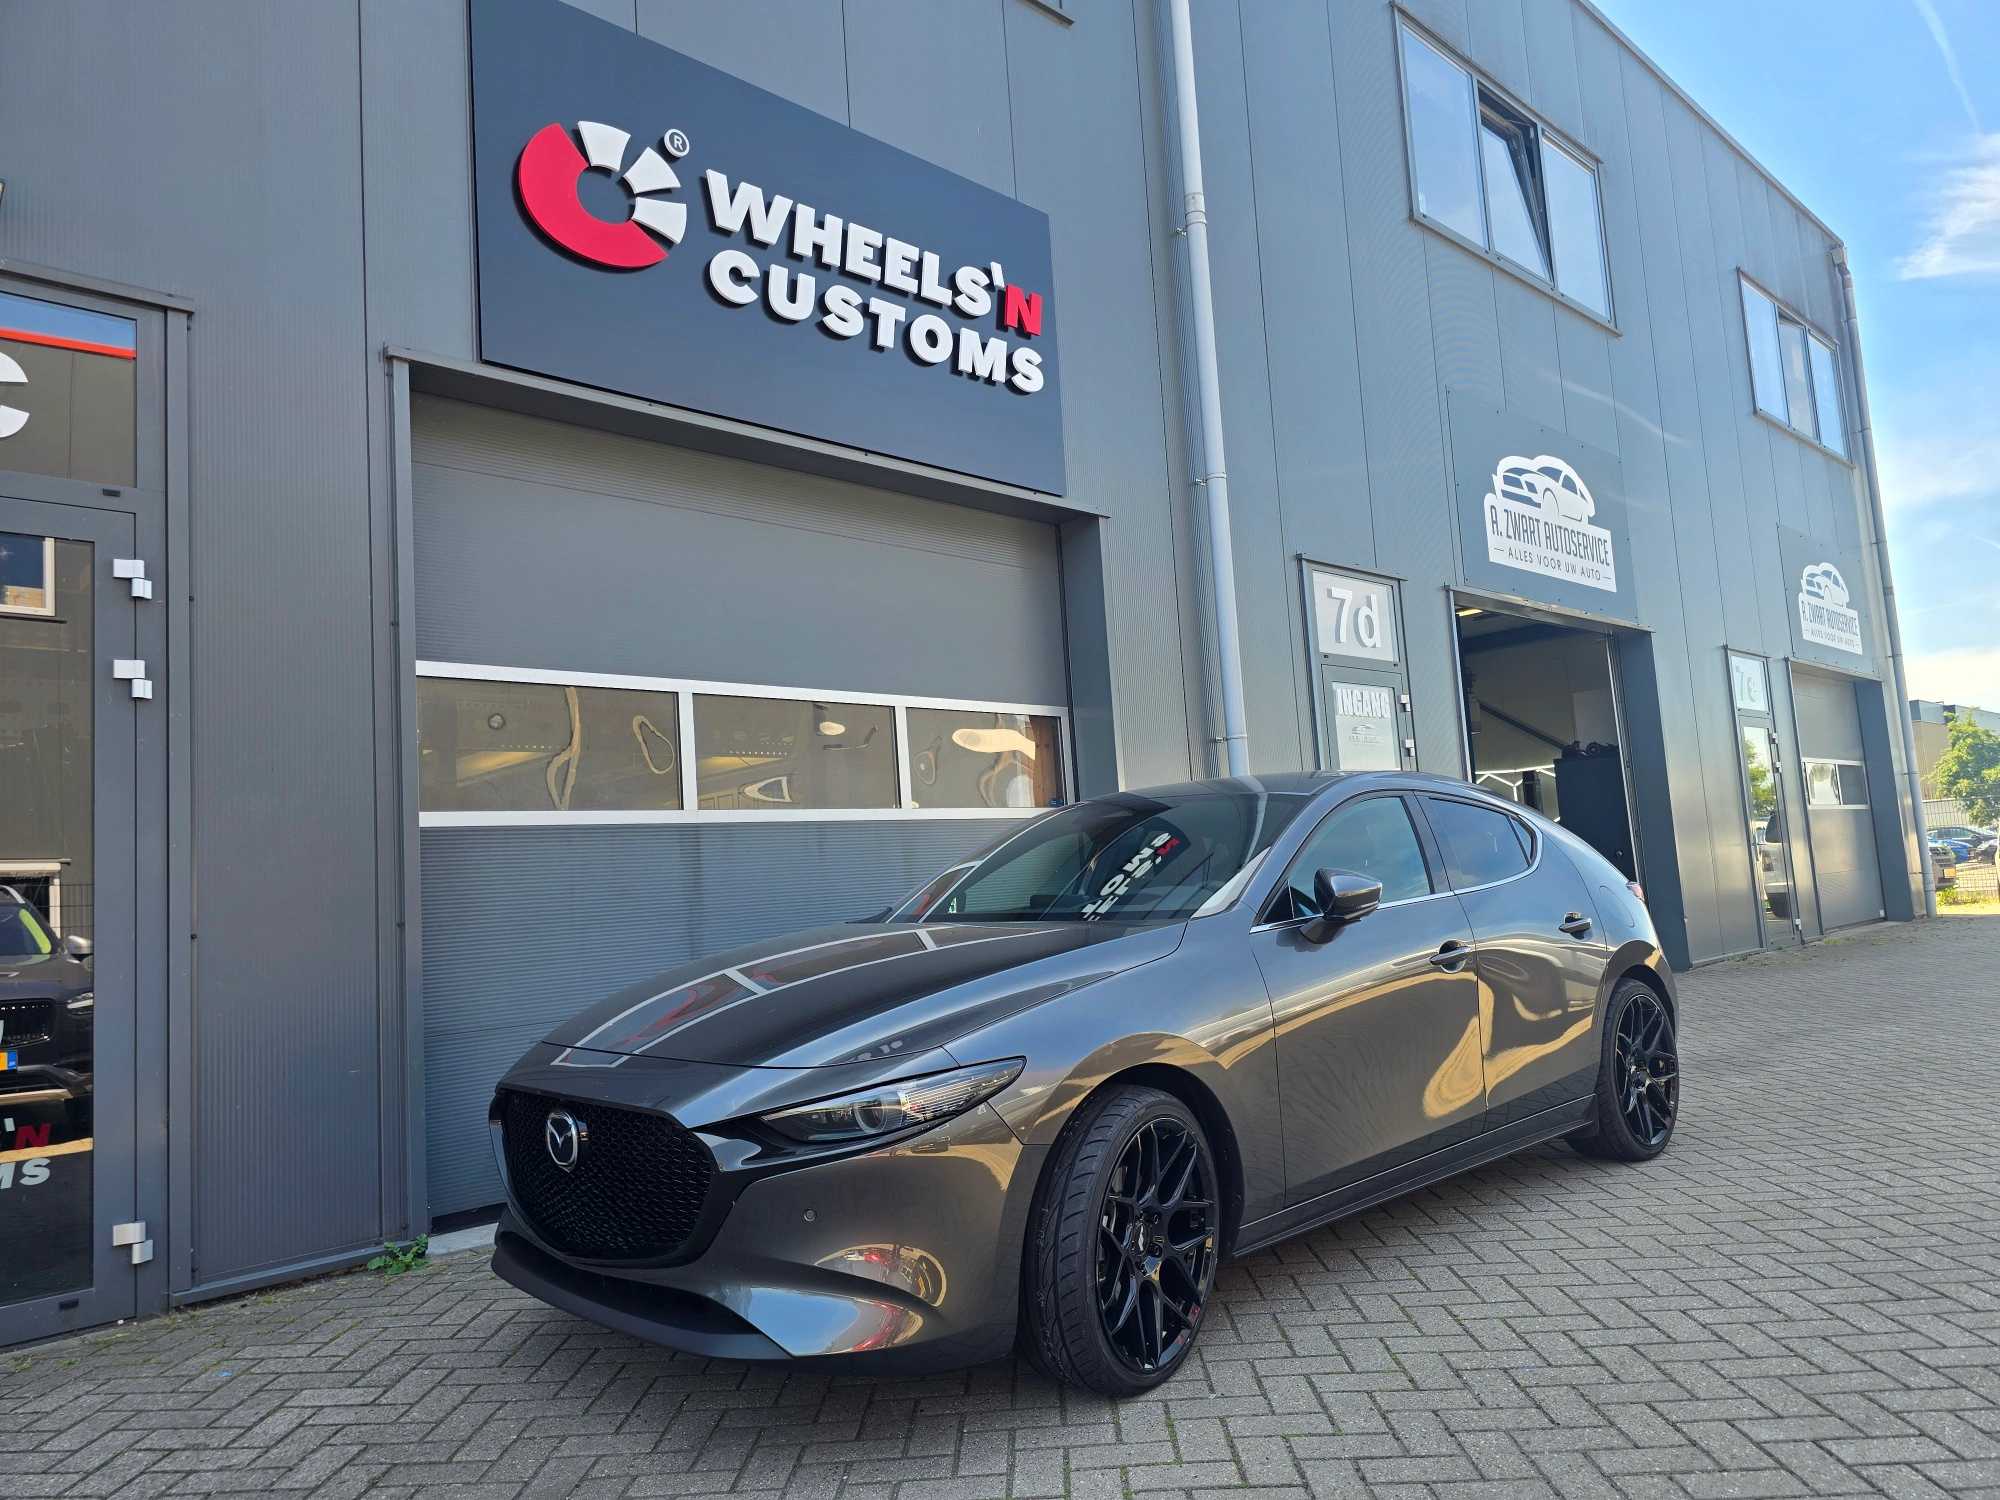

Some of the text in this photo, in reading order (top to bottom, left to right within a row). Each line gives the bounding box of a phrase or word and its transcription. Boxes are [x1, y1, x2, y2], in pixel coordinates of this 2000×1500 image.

[705, 169, 1042, 336] WHEELS'N
[709, 249, 1045, 393] CUSTOMS
[1490, 504, 1610, 567] A. ZWART AUTOSERVICE
[1508, 546, 1601, 581] ALLES VOOR UW AUTO
[1330, 586, 1381, 649] 7d
[1336, 688, 1391, 719] INGANG
